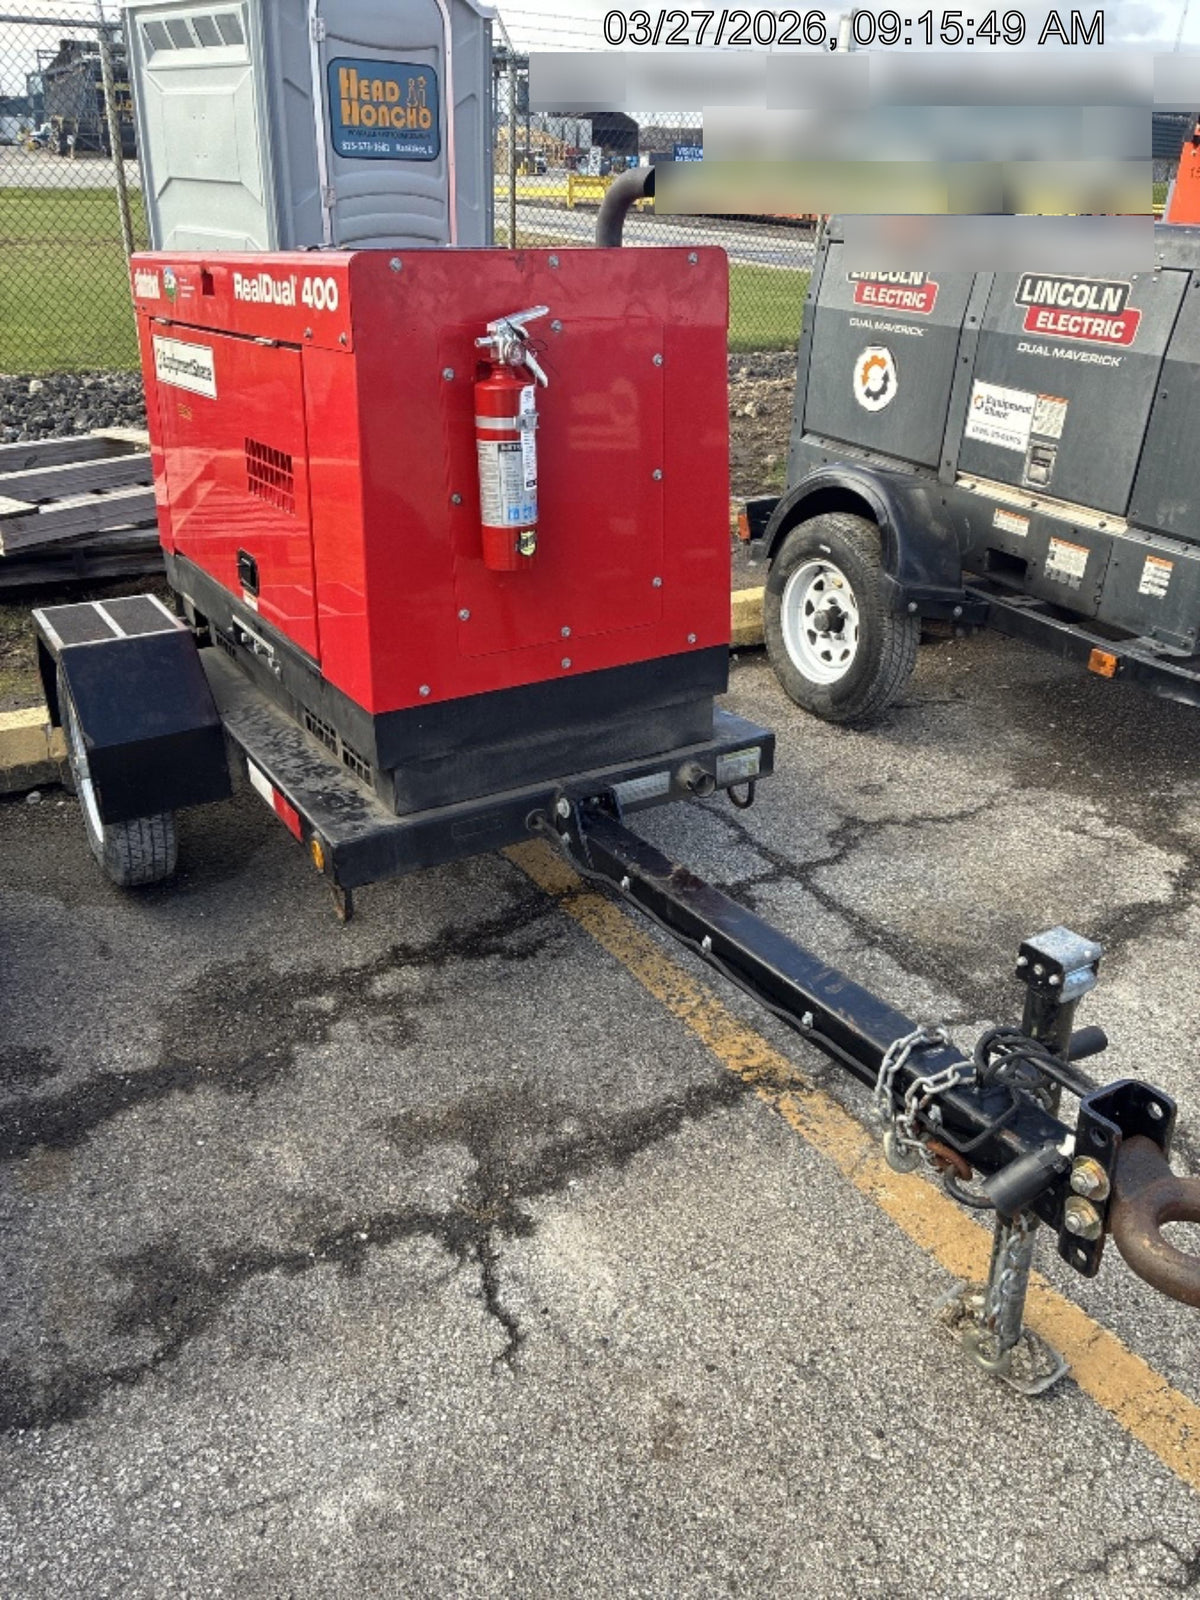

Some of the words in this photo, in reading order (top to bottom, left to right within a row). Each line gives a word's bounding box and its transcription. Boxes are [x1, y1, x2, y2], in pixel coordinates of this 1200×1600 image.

[341, 99, 431, 129] HONCHO
[233, 272, 296, 306] RealDual
[302, 277, 338, 312] 400
[862, 286, 927, 308] ELECTRIC
[1020, 277, 1123, 311] LINCOLN
[849, 317, 873, 328] DUAL
[874, 321, 924, 337] MAVERICK
[1036, 310, 1126, 339] ELECTRIC
[1016, 342, 1051, 357] DUAL
[1052, 347, 1121, 368] MAVERICK
